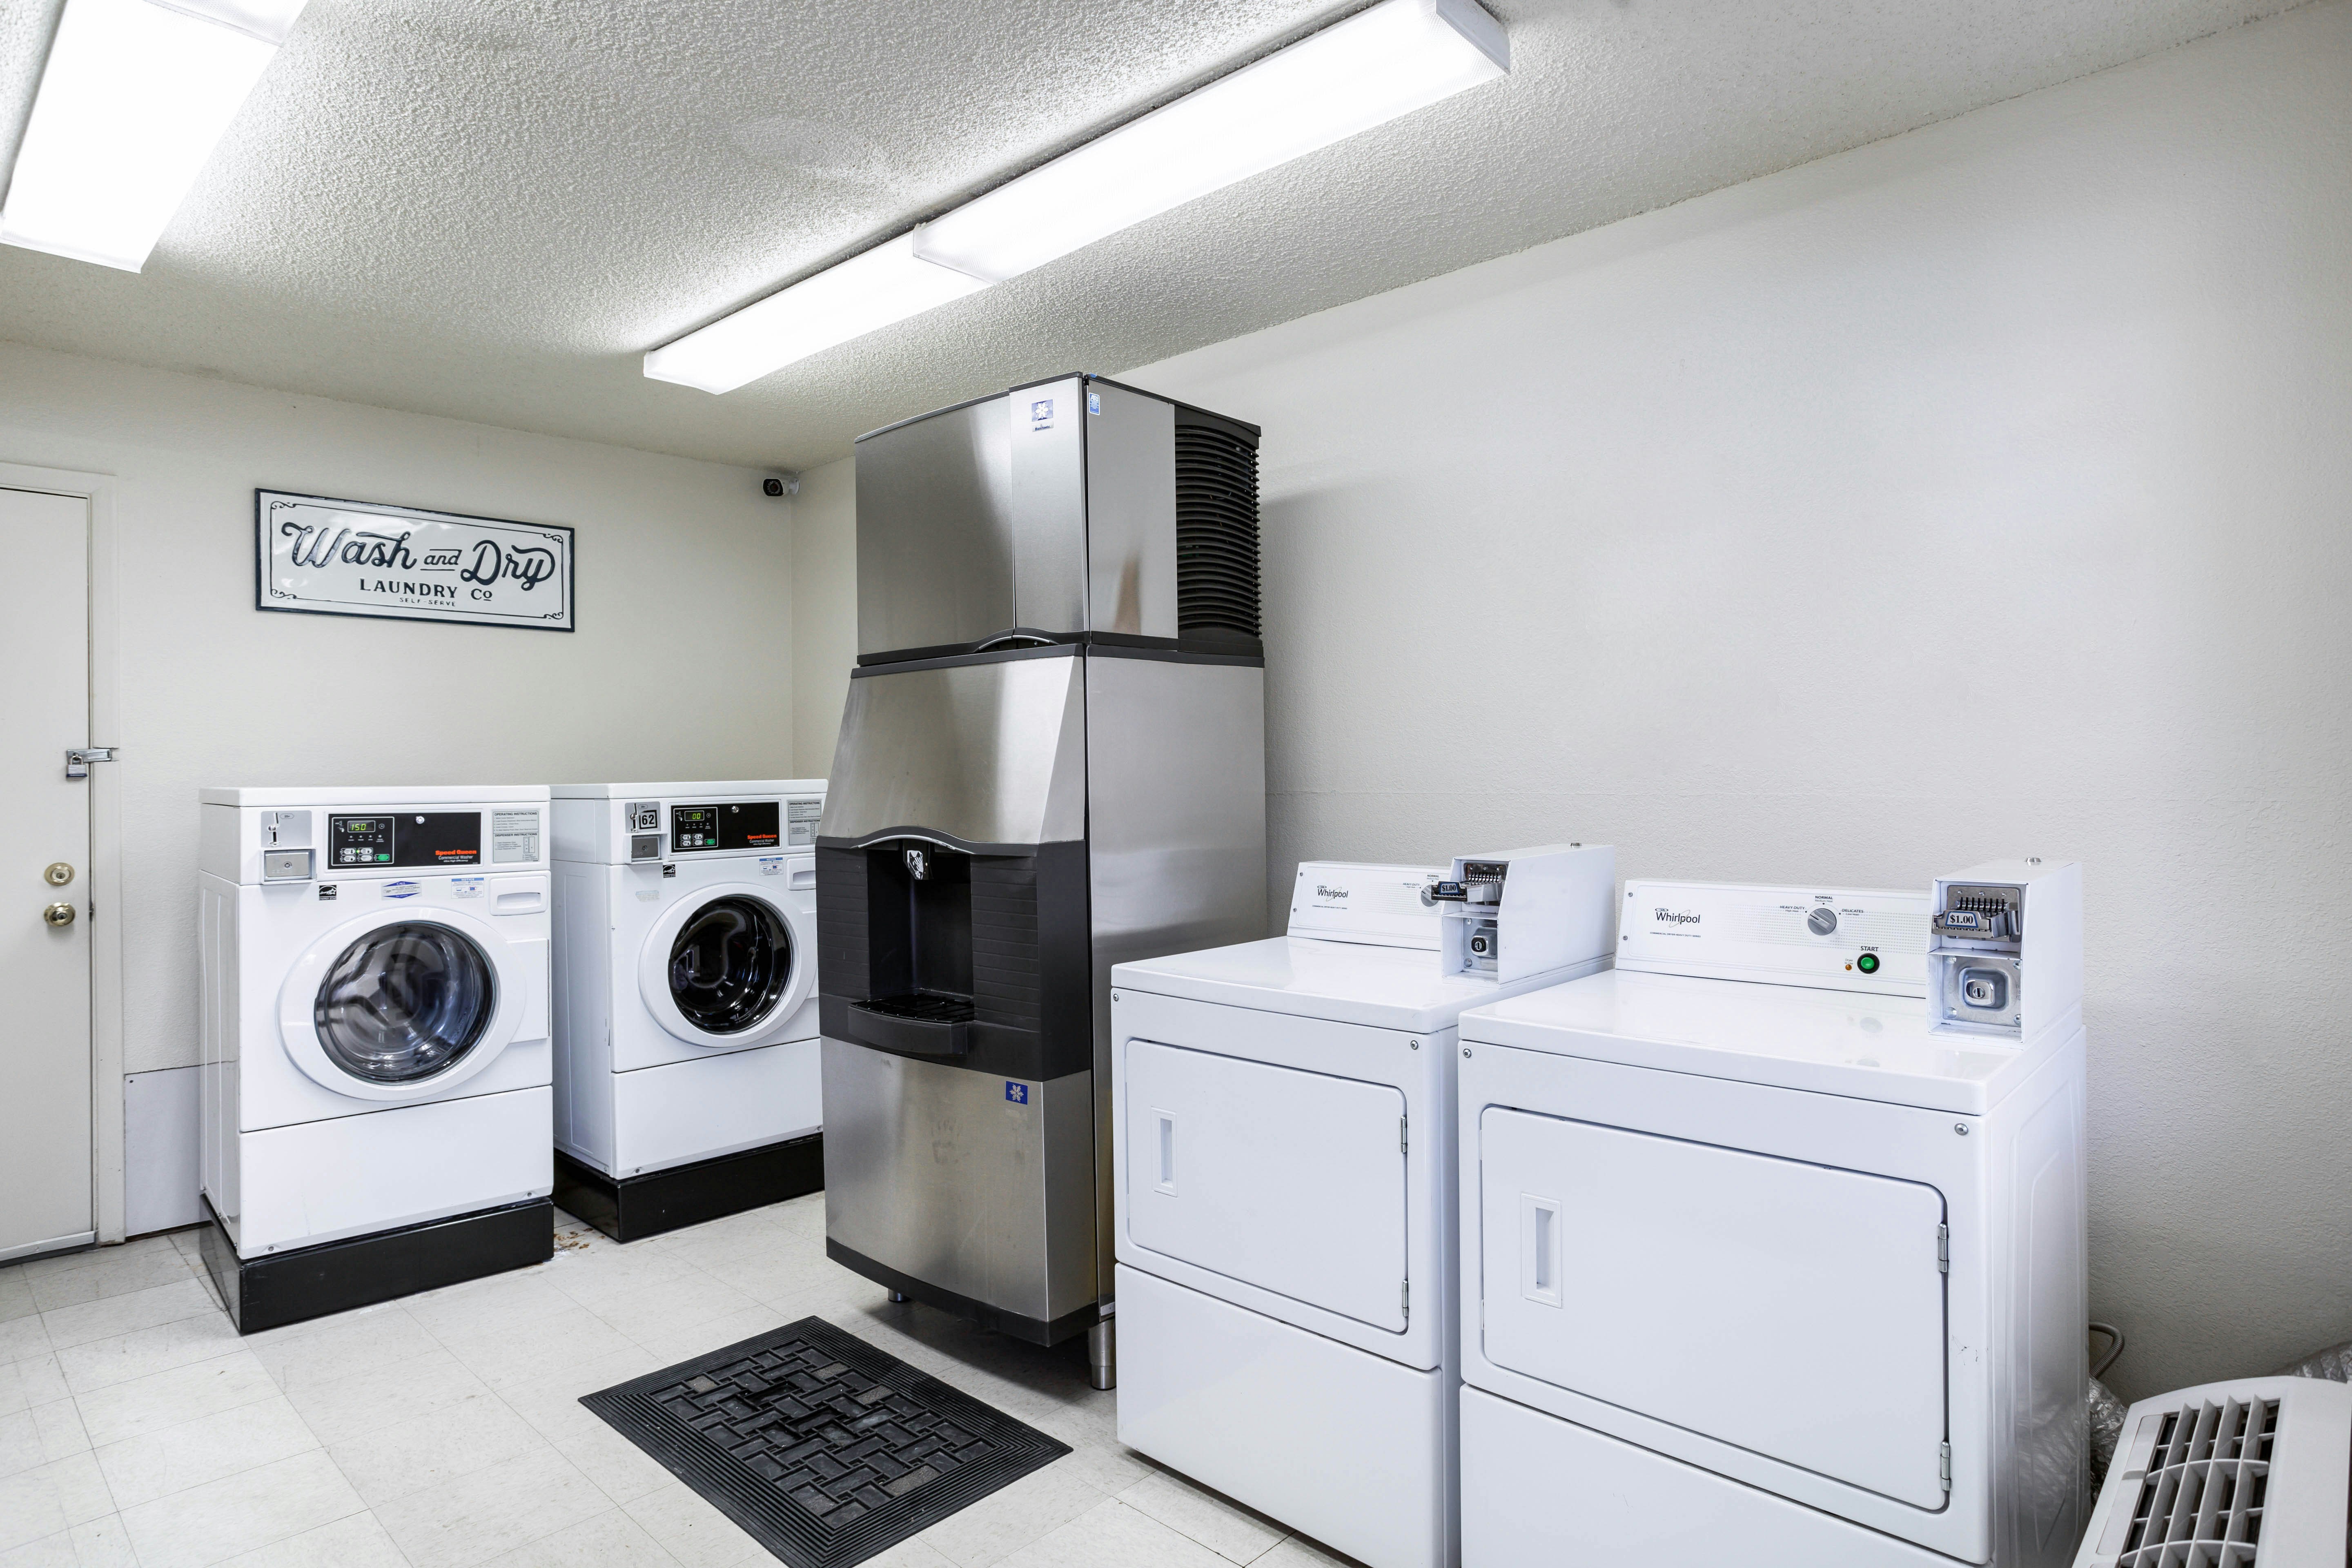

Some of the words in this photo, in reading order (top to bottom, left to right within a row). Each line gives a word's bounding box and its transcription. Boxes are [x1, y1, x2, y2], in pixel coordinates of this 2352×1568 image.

[281, 522, 417, 569] Wash
[423, 549, 462, 565] and
[460, 540, 555, 591] Dry
[360, 578, 457, 598] LAUNDRY
[400, 597, 456, 606] SELF-SERVE
[642, 814, 655, 825] 62
[1318, 889, 1348, 899] Whirlpool
[1656, 912, 1700, 924] Whirlpool
[1950, 915, 1973, 924] $1.00
